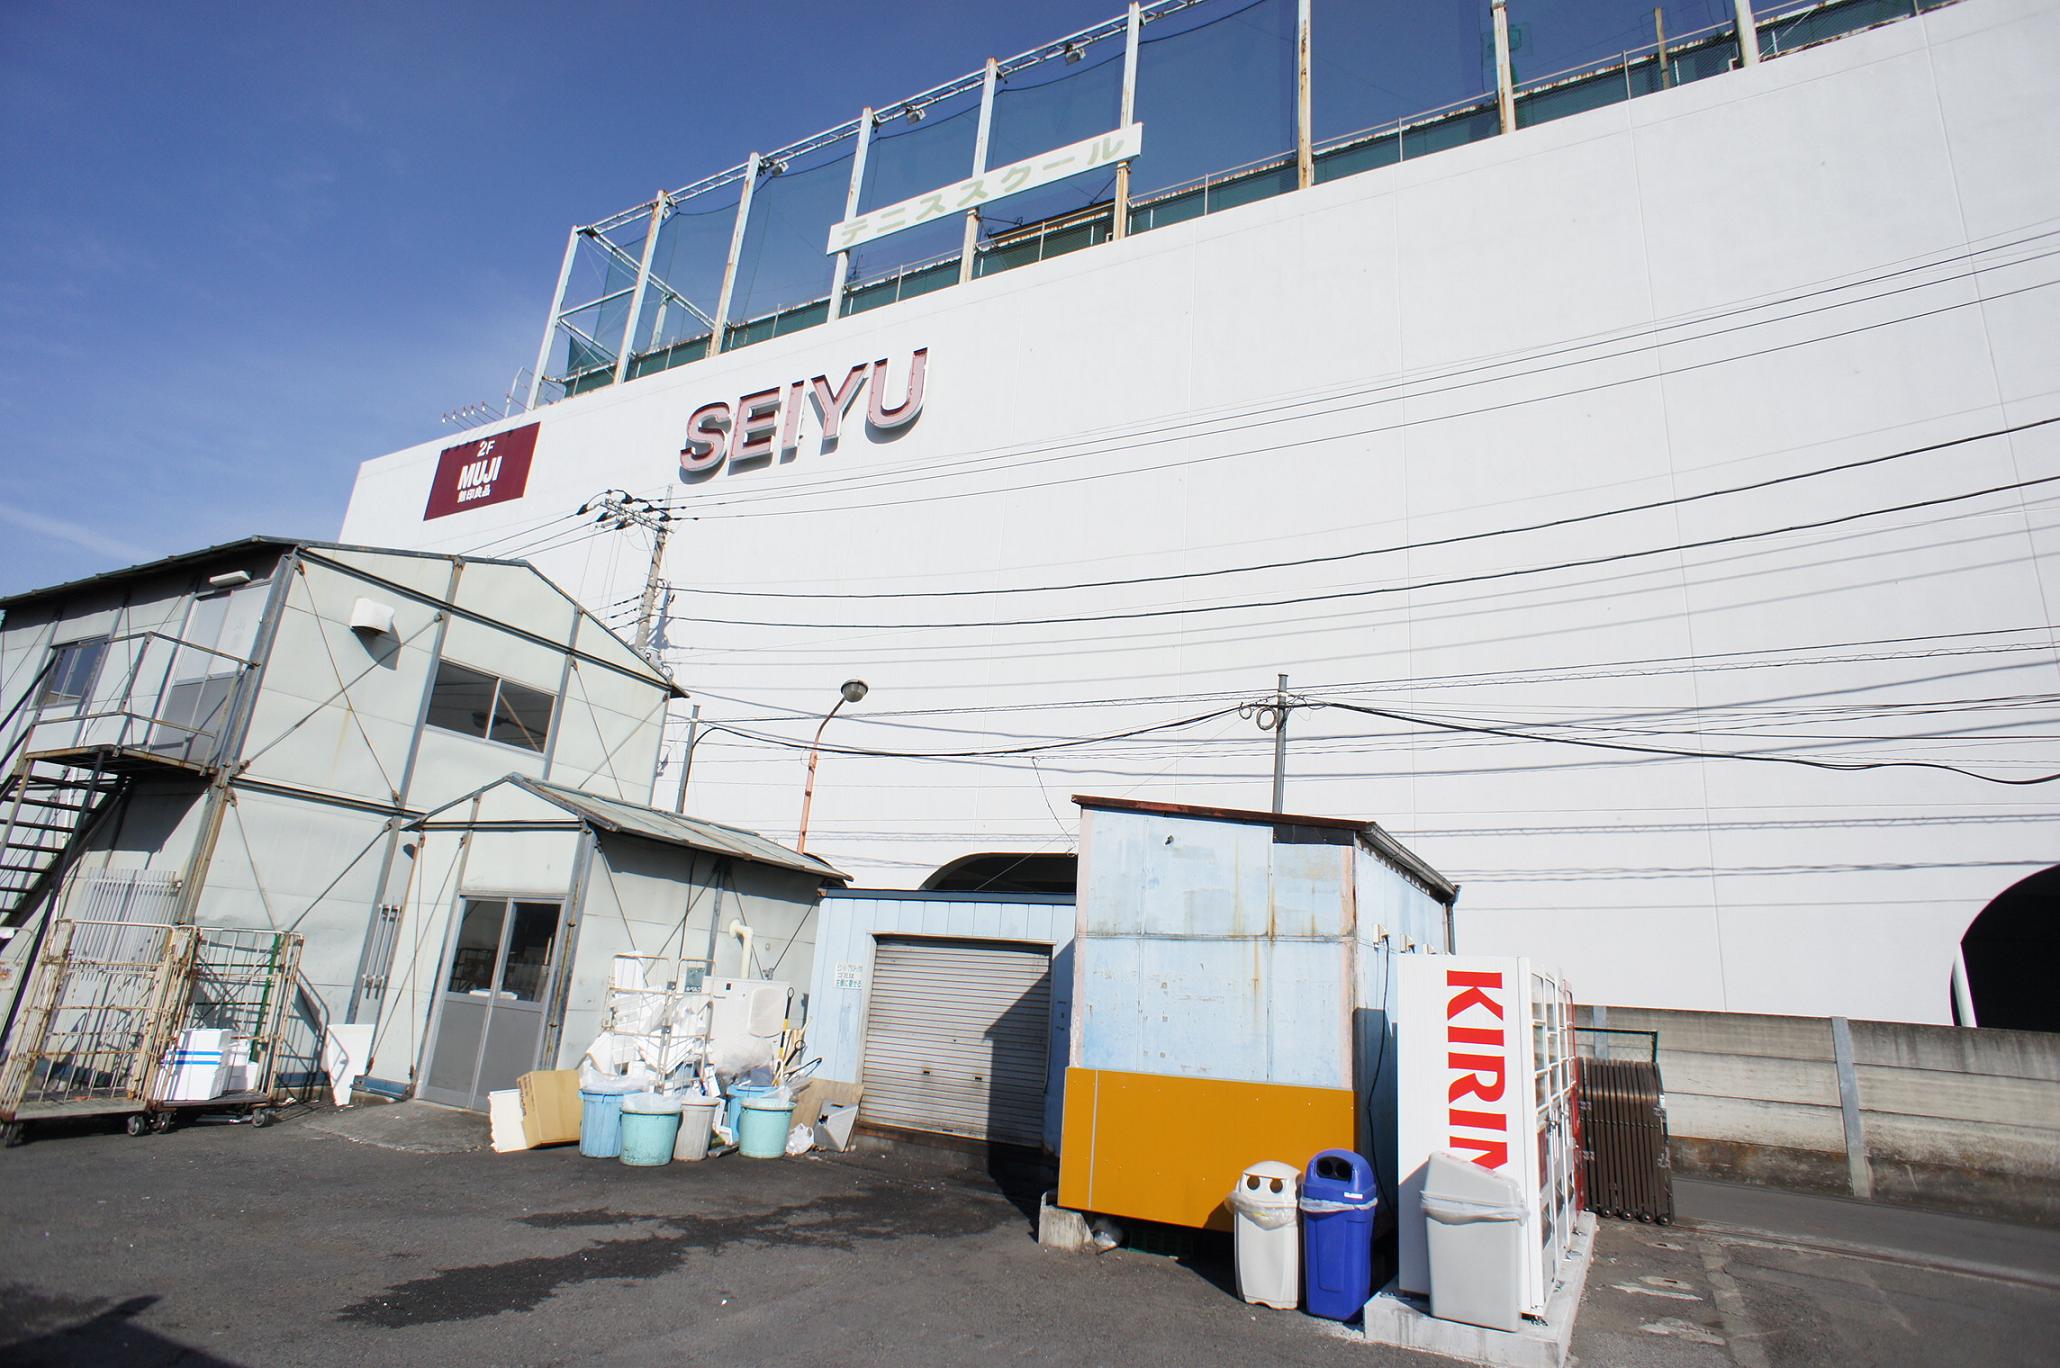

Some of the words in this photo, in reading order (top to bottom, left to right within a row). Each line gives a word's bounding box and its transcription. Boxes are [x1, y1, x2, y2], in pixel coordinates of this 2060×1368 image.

[841, 135, 1124, 246] テニススクール
[680, 347, 928, 473] SEIYU
[457, 456, 502, 490] MUJI
[477, 440, 496, 457] 2F
